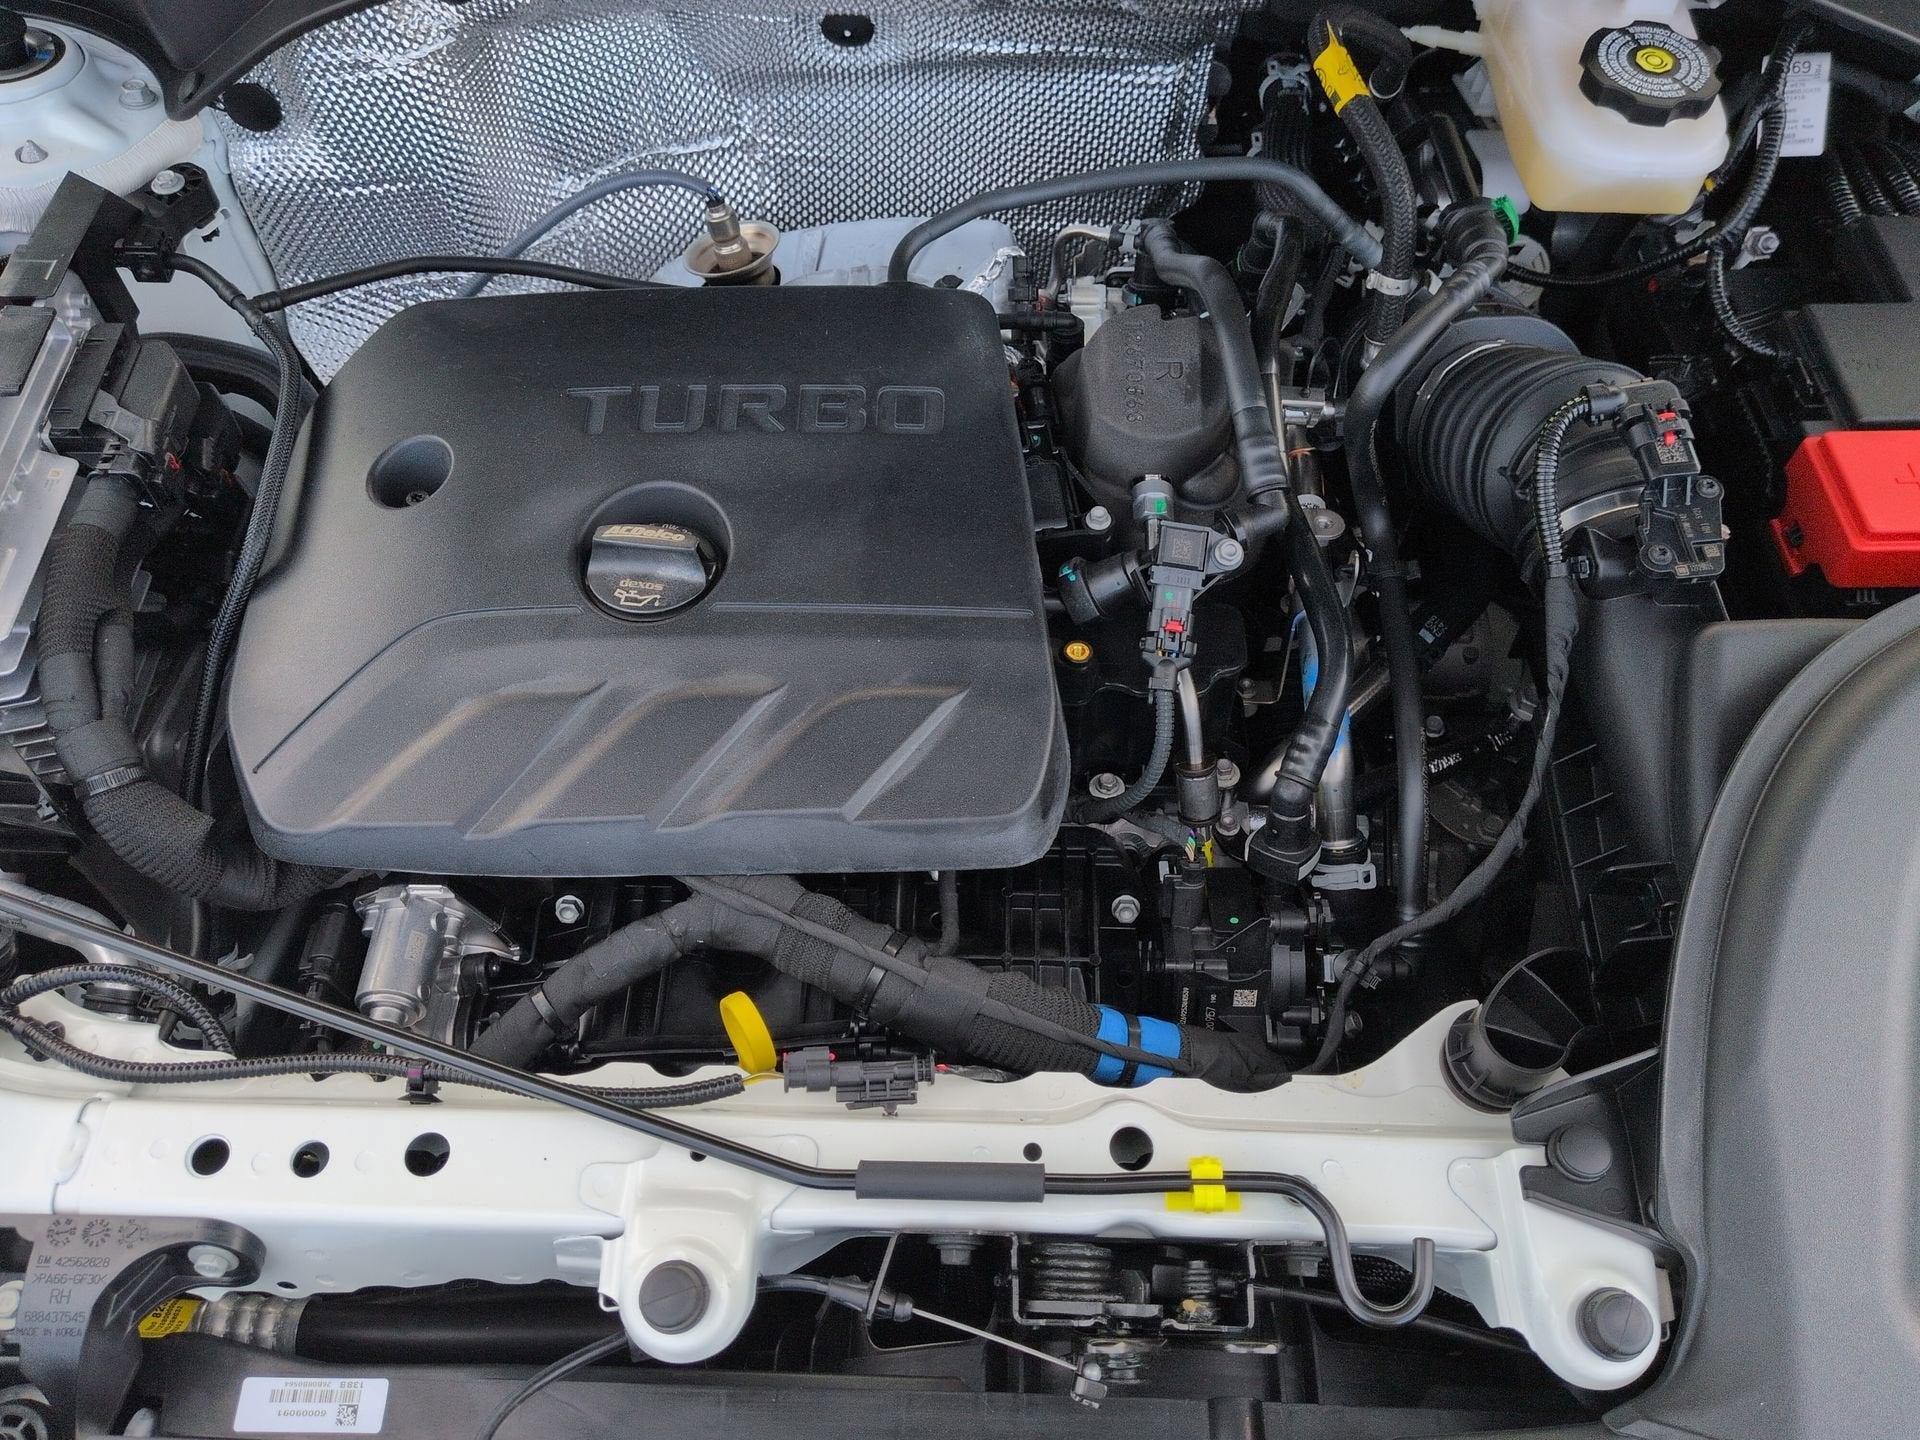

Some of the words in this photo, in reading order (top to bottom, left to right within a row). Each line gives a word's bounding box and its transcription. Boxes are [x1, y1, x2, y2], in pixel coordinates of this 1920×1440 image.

[1156, 361, 1184, 381] R
[567, 383, 945, 434] TURBO
[605, 525, 686, 542] ACDelco
[620, 578, 665, 591] dexos
[36, 1255, 51, 1265] GM
[55, 1256, 111, 1268] 42562828
[49, 1288, 72, 1305] RH
[24, 1311, 86, 1323] 688437545
[43, 1327, 52, 1337] IN
[55, 1327, 82, 1337] KOREA
[277, 1409, 327, 1417] 60009091
